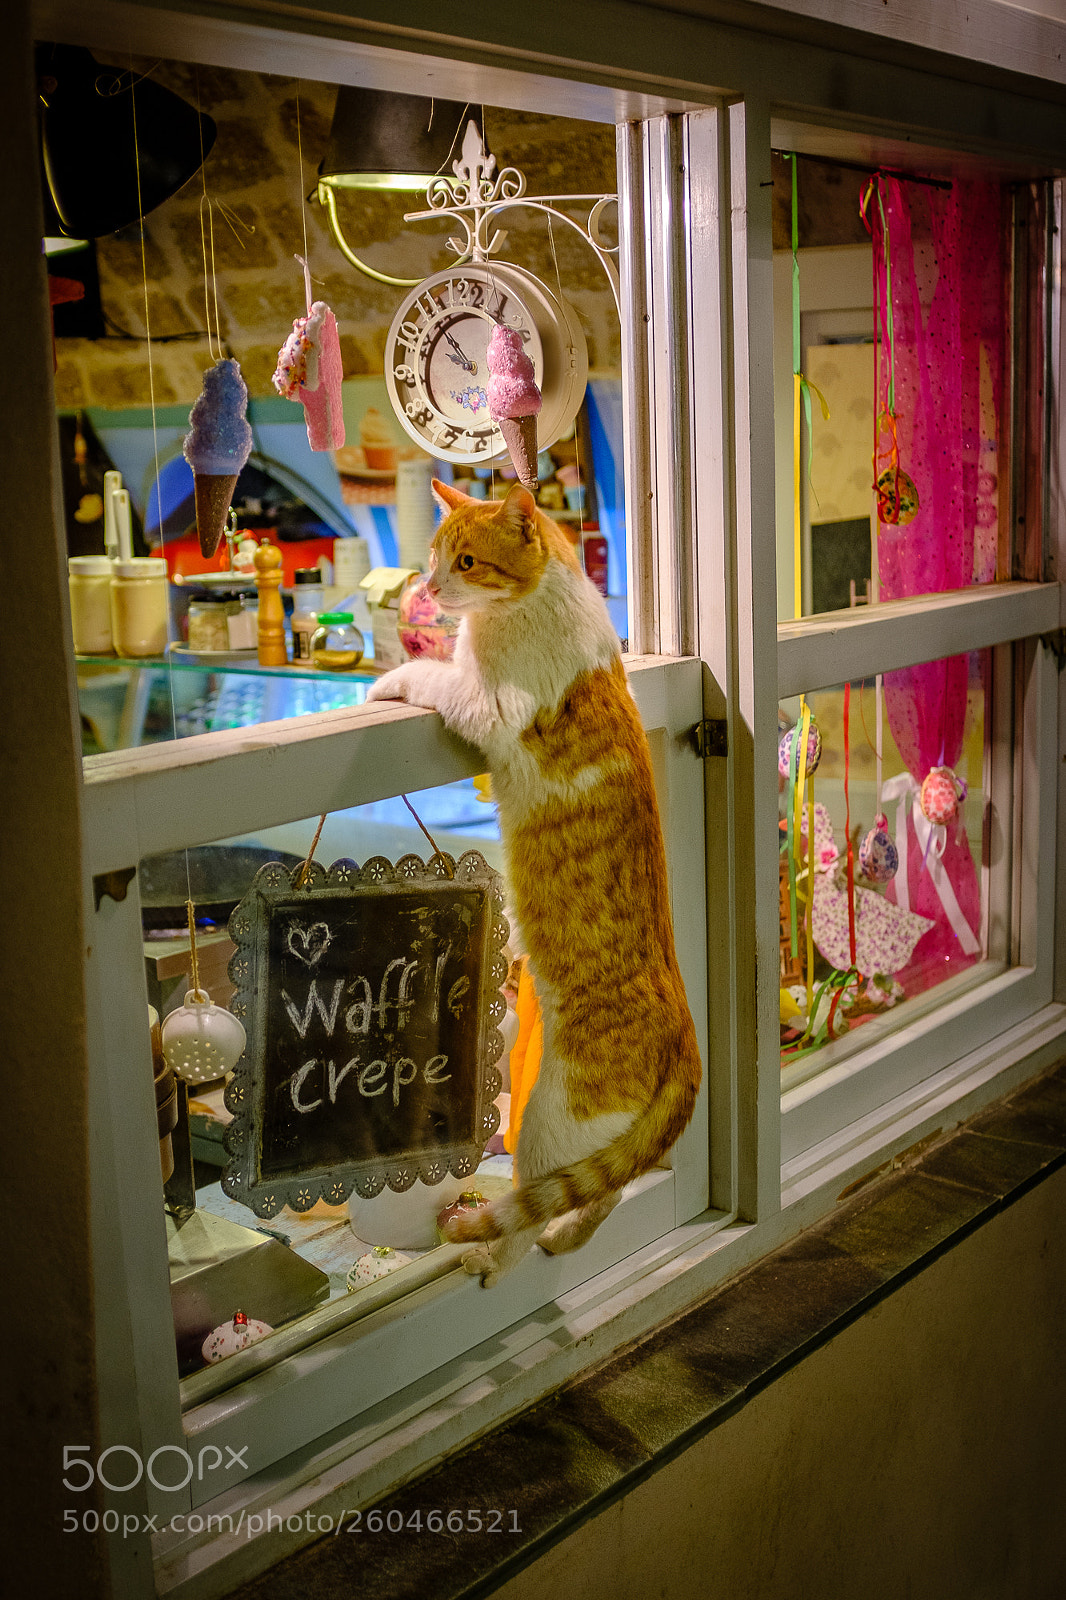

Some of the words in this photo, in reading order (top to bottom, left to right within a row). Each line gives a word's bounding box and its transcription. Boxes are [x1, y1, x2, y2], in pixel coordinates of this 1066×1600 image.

[415, 290, 444, 322] 11
[445, 278, 470, 307] 12
[395, 320, 421, 353] 10
[393, 364, 415, 381] 9
[405, 398, 424, 418] 8
